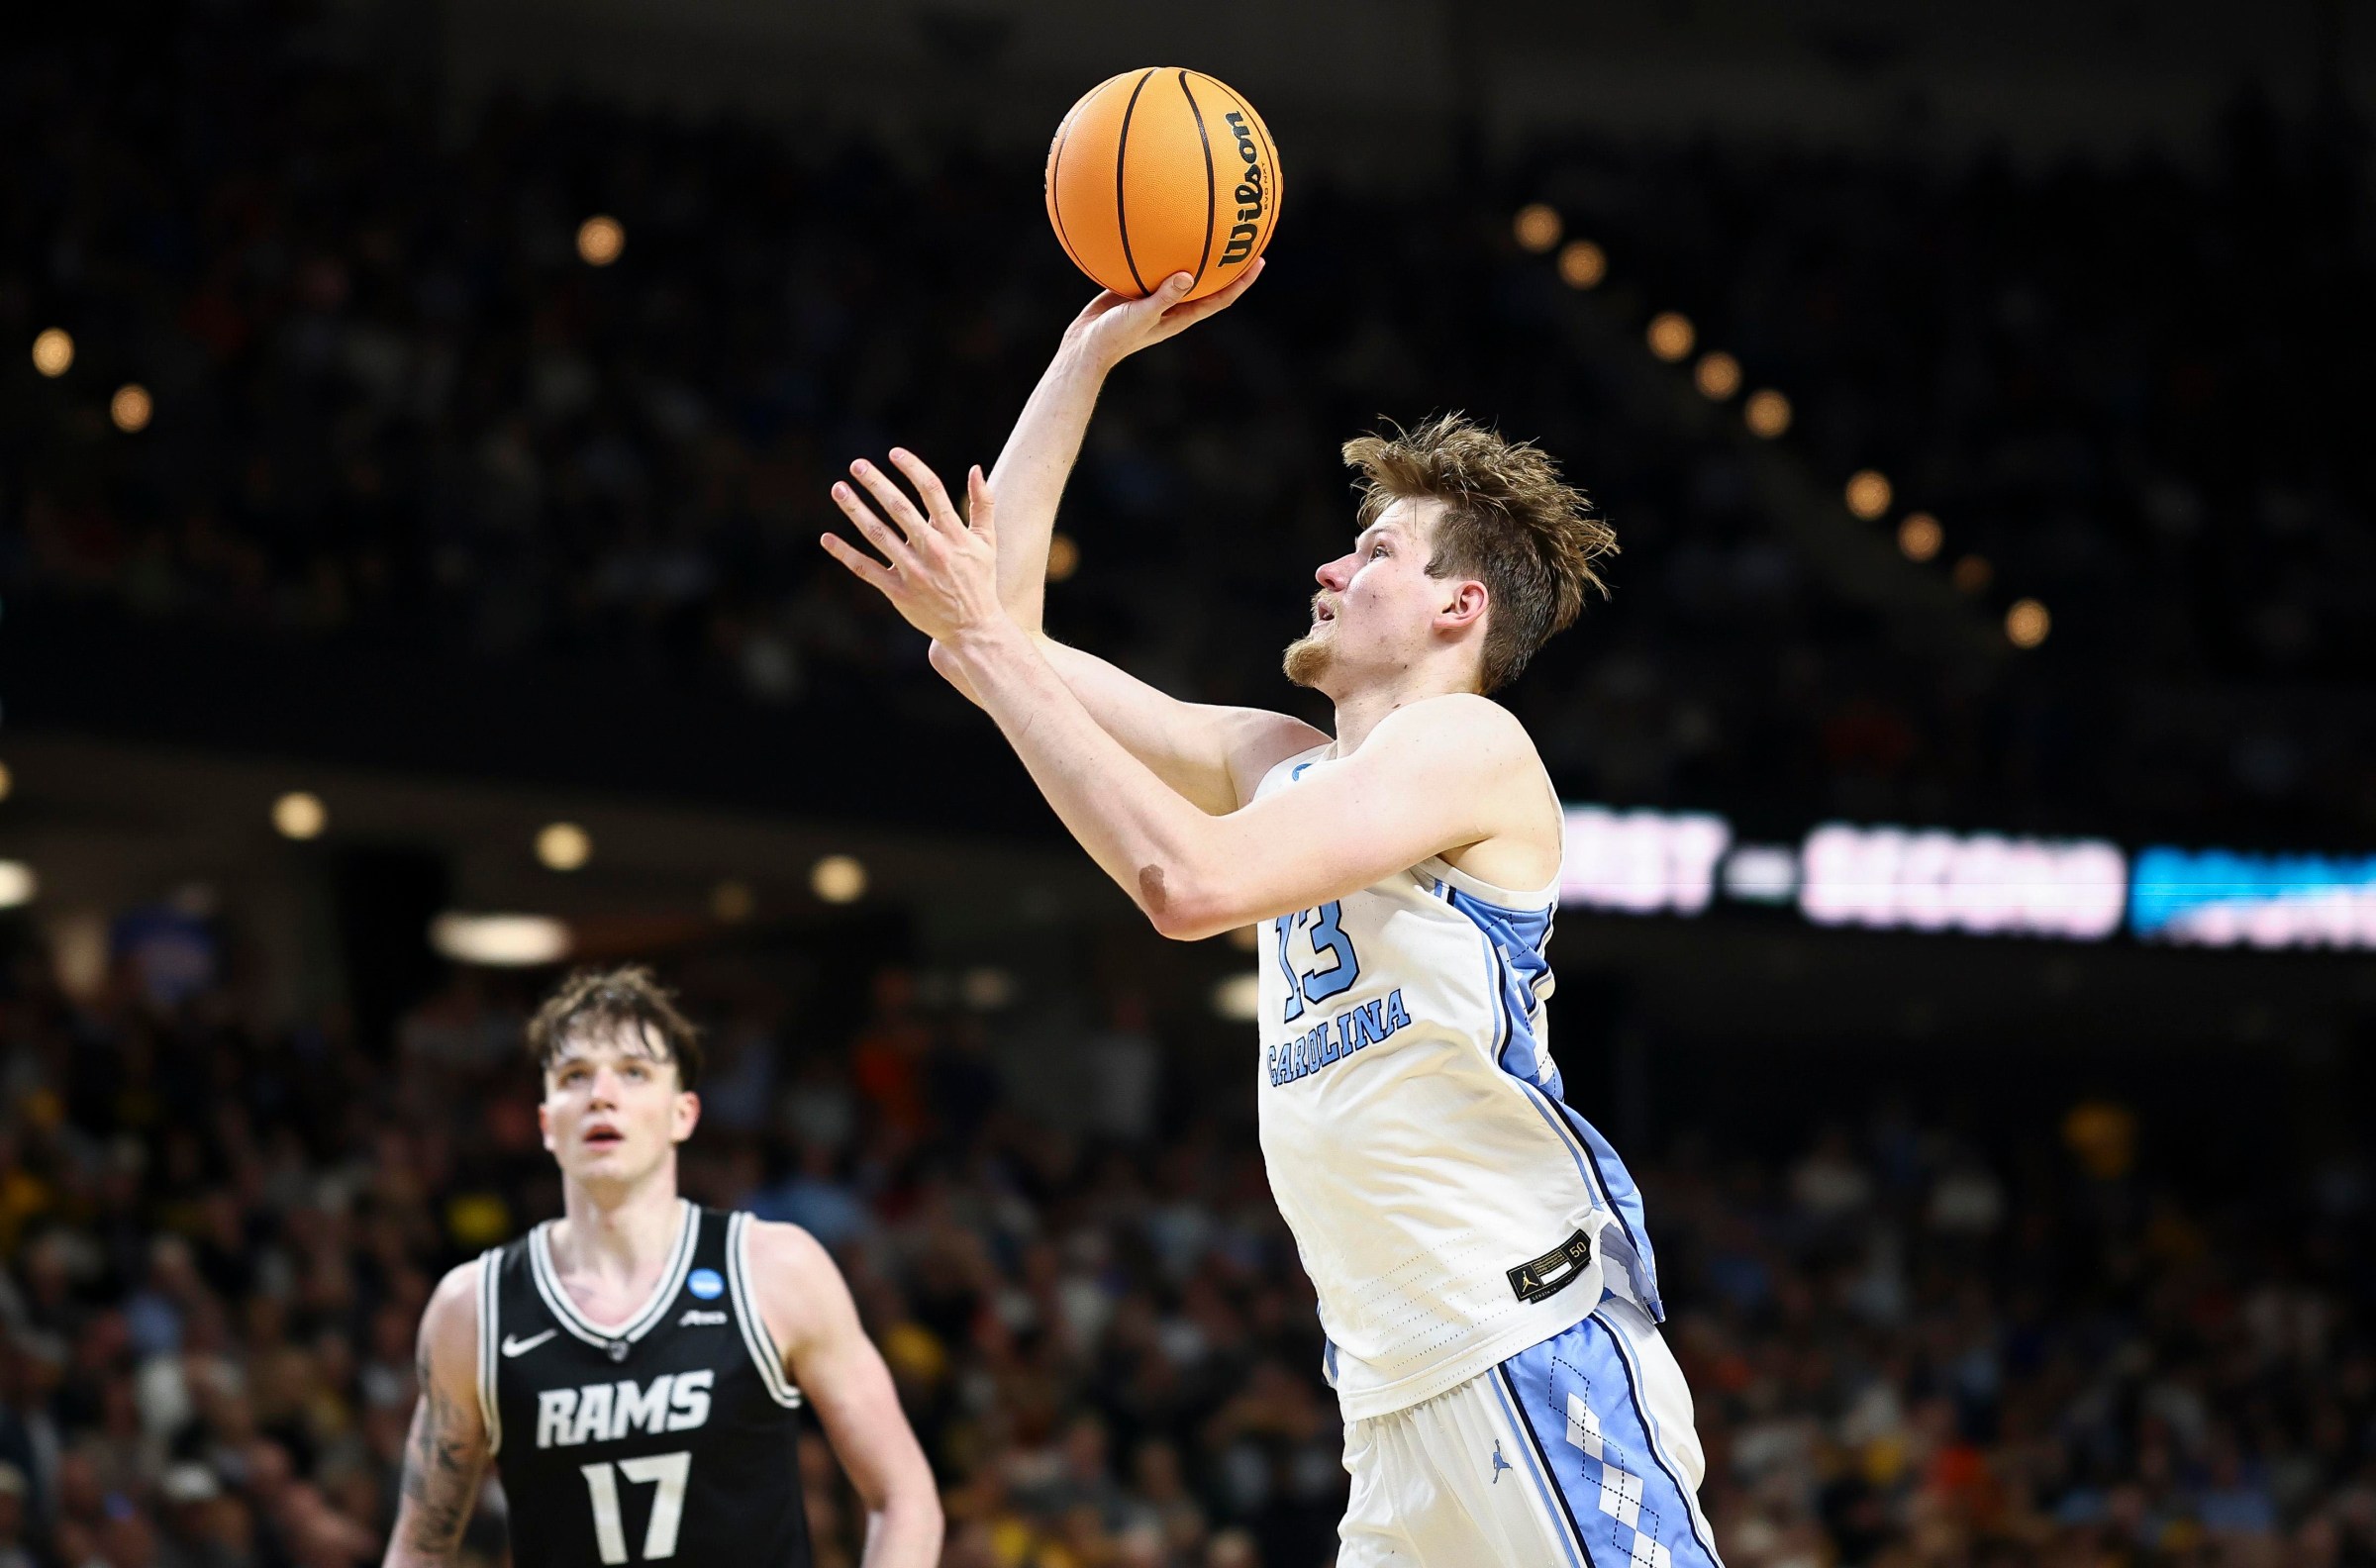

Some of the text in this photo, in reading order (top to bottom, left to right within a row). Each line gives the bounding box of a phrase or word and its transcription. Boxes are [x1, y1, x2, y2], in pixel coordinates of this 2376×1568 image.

[1217, 111, 1263, 269] Wilson
[1275, 900, 1360, 1025] 13
[1267, 988, 1412, 1087] CAROLINA
[1569, 1241, 1586, 1257] 50
[537, 1369, 715, 1449] RAMS
[580, 1450, 692, 1565] 17
